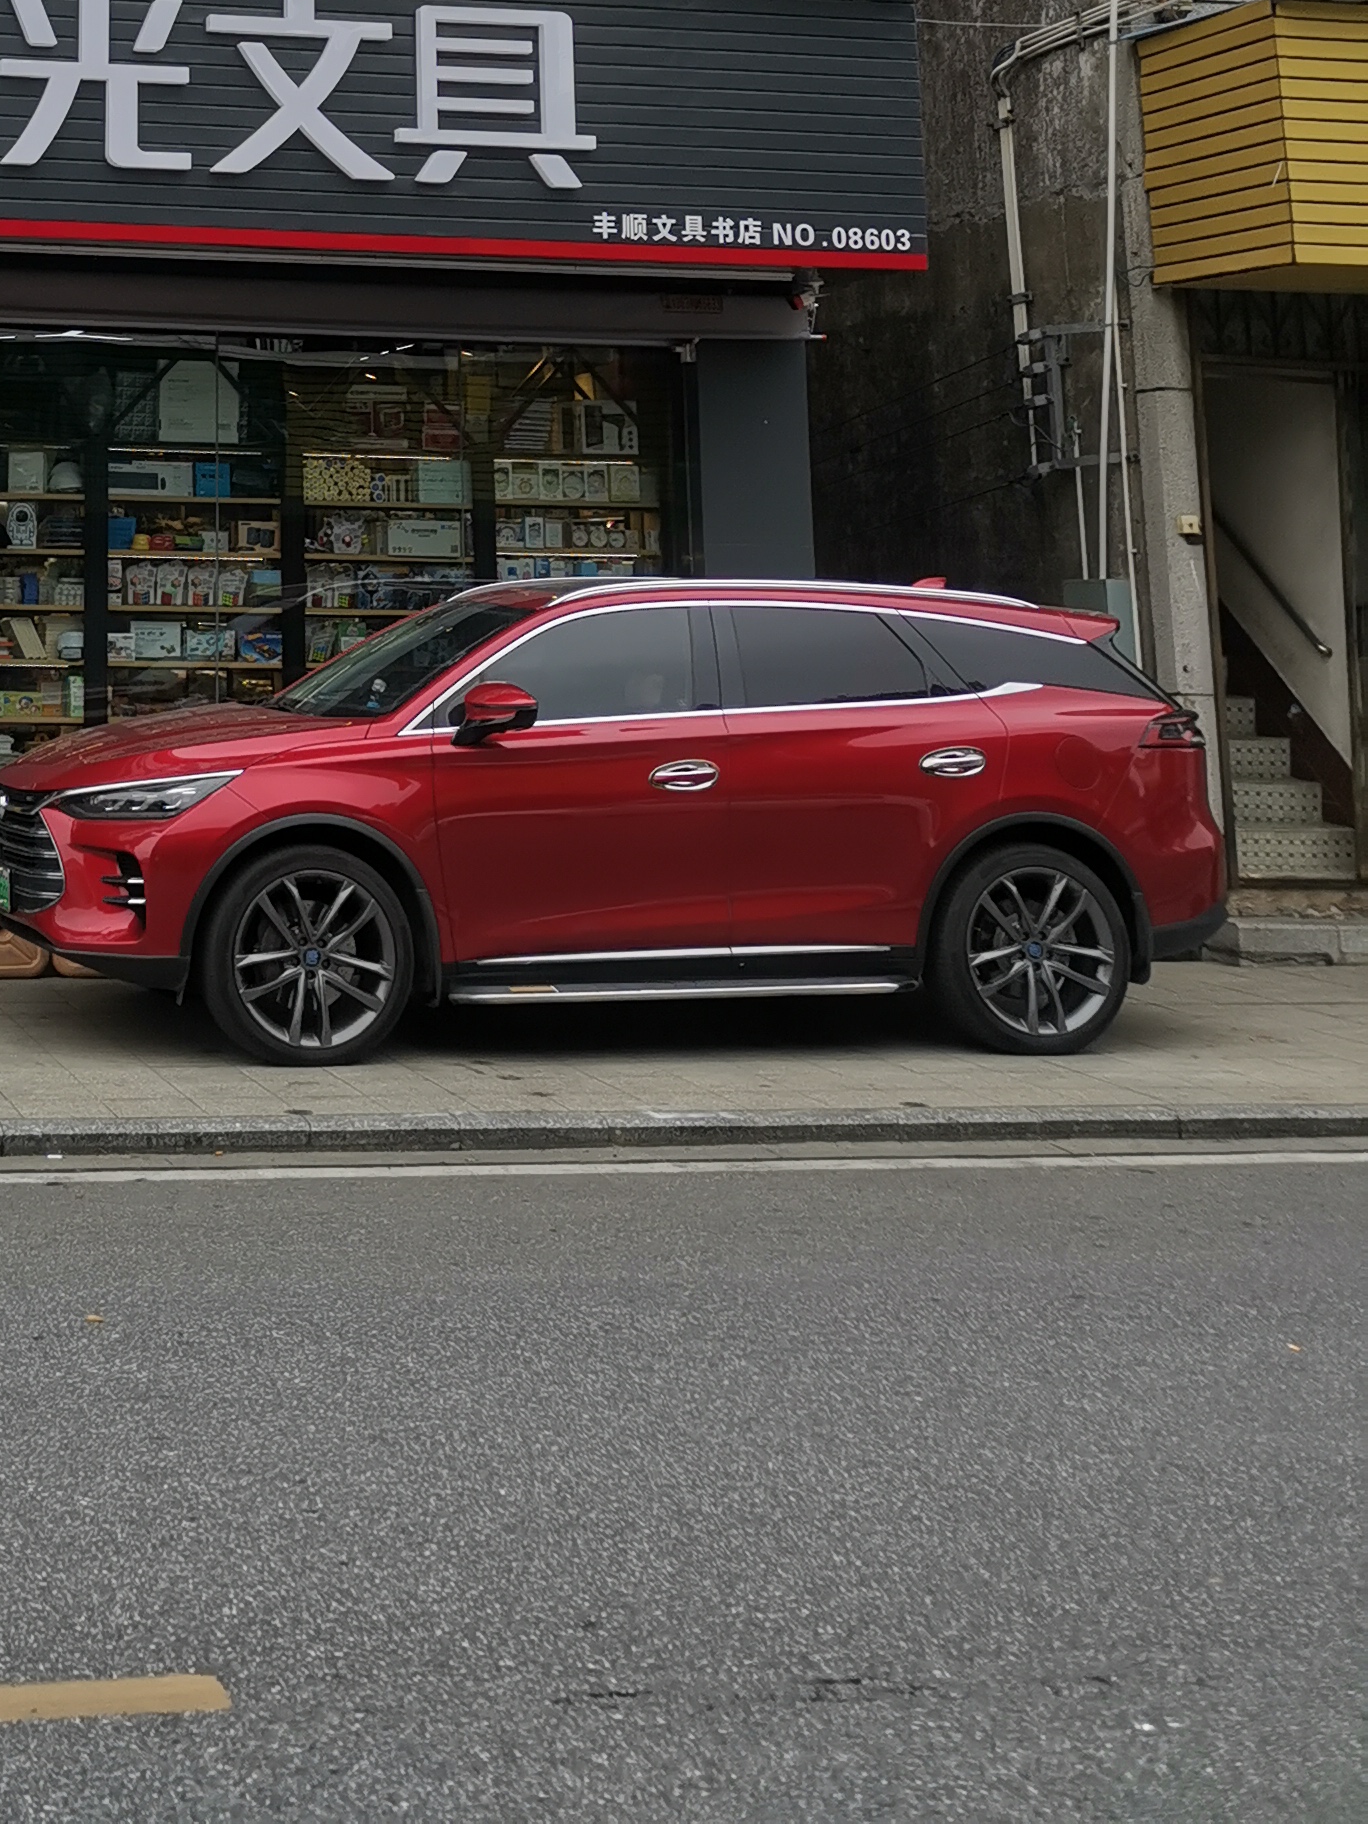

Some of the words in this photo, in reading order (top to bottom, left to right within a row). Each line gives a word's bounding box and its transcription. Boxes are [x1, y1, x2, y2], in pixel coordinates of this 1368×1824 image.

[592, 212, 762, 245] 丰顺文具书店
